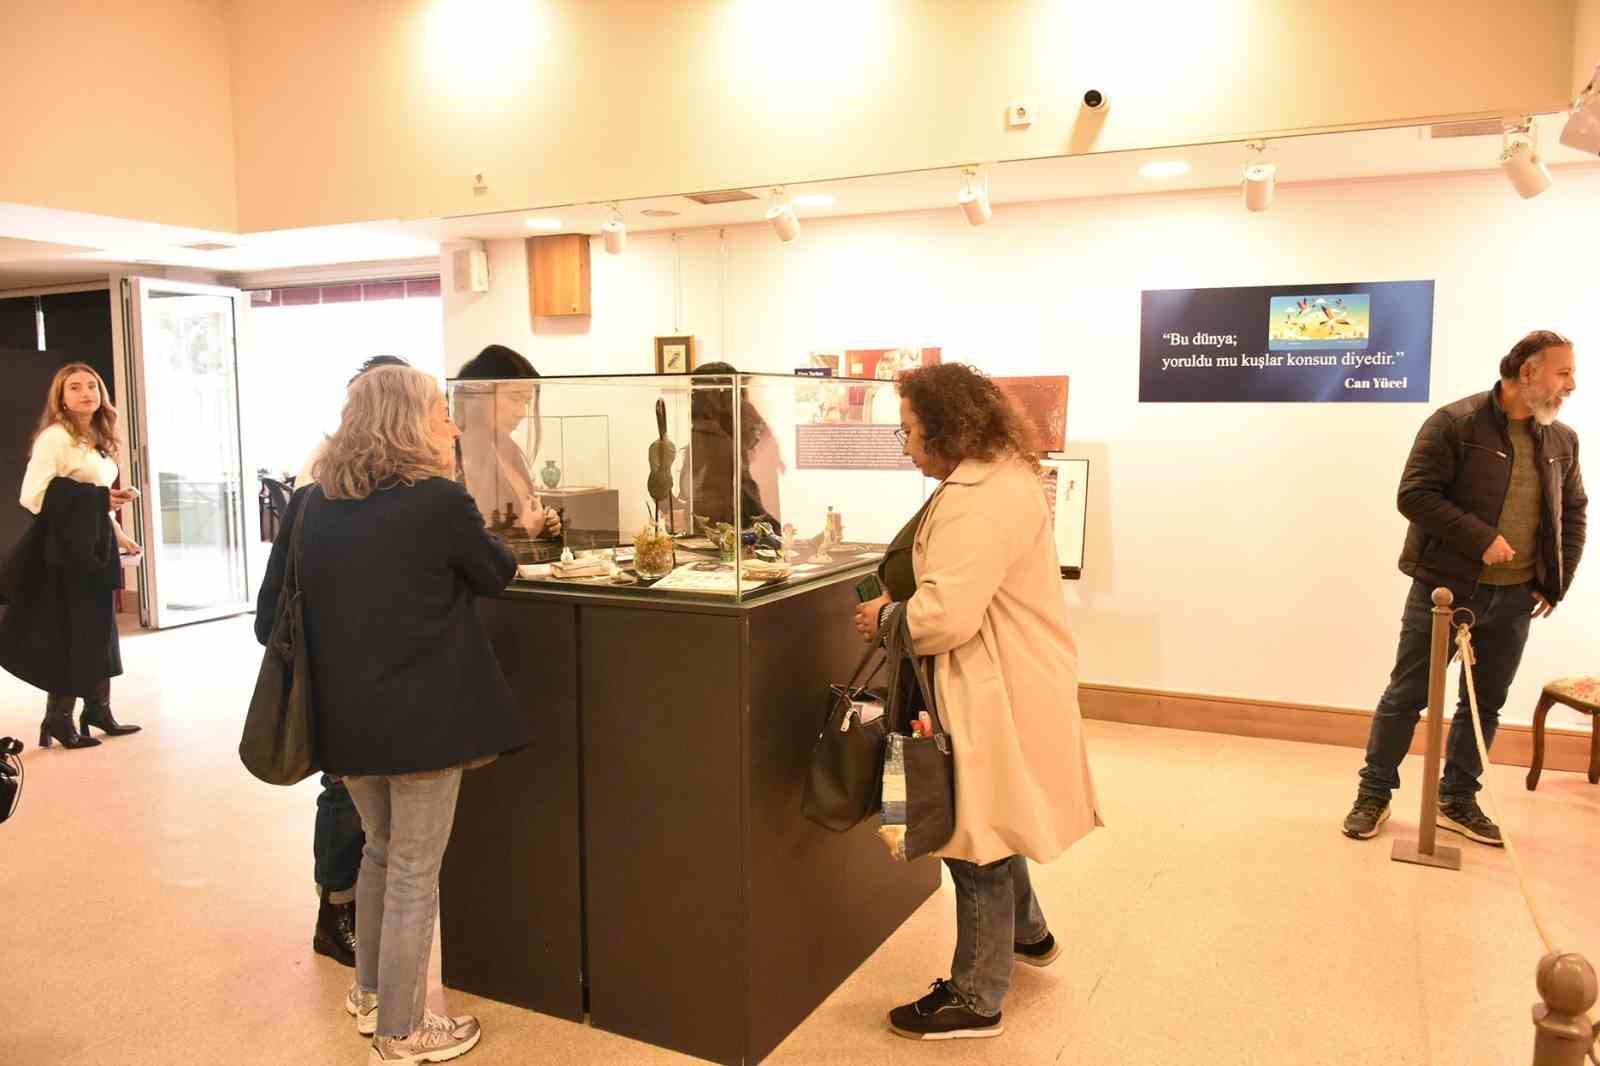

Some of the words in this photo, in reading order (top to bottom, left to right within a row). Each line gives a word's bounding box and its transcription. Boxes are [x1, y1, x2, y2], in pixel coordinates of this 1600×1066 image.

[1162, 332, 1189, 346] “Bu
[1192, 331, 1237, 348] dünya;
[1161, 353, 1212, 370] yoruldu
[1216, 356, 1238, 367] mu
[1240, 353, 1283, 369] kuşlar
[1286, 352, 1337, 366] konsun
[1341, 351, 1404, 368] diyedir.”
[1344, 377, 1370, 389] Can
[1373, 376, 1407, 388] Yücel
